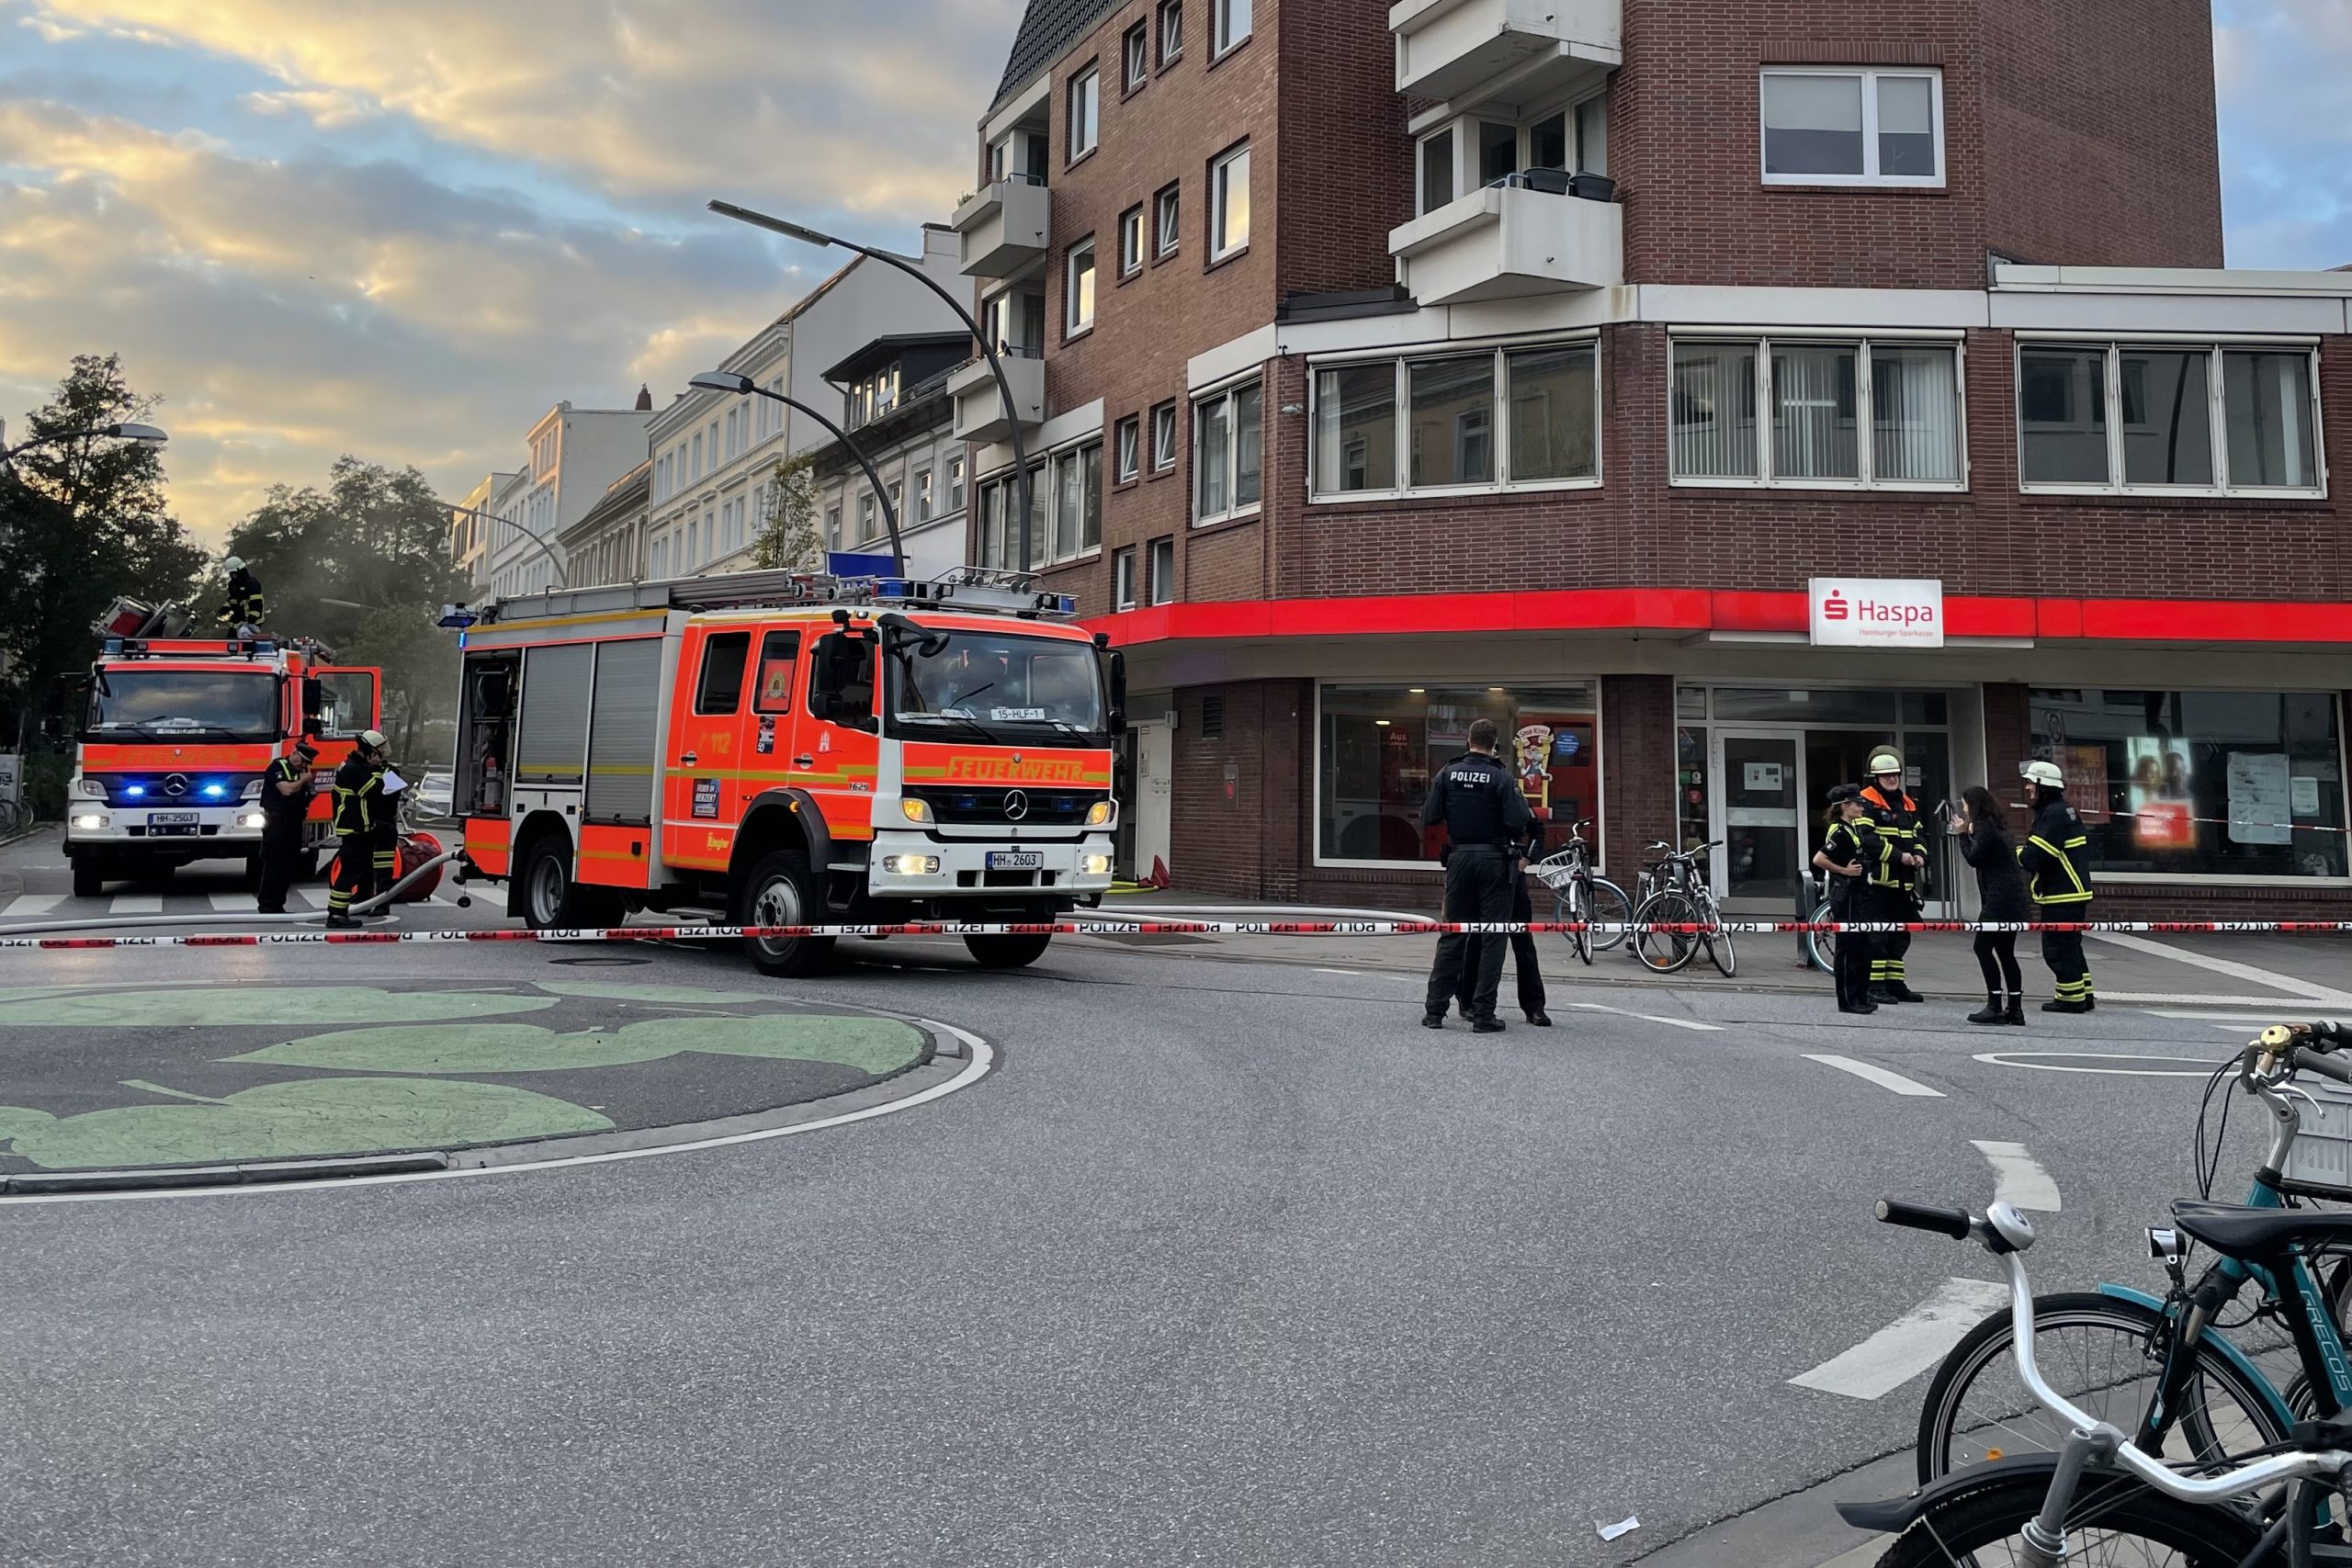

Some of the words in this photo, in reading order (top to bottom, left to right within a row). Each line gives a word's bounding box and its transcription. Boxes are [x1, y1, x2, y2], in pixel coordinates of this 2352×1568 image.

[1859, 599, 1933, 626] Haspa
[1860, 628, 1897, 637] Hamburger
[1899, 628, 1934, 637] Sparkasse
[997, 709, 1039, 719] 15-HLF-1
[711, 732, 732, 754] 112
[947, 756, 1084, 782] FEUERWEHR
[1450, 771, 1490, 784] POLIZEI
[849, 783, 869, 791] 1629
[173, 814, 194, 822] 2503
[993, 854, 1006, 866] HH
[1013, 854, 1036, 866] 2603
[920, 924, 984, 933] POLIZEI
[1079, 923, 1142, 932] POLIZEI
[1158, 923, 1220, 932] POLIZEI
[1236, 923, 1298, 932] POLIZEI
[1314, 922, 1375, 932] POLIZEI
[1391, 922, 1453, 932] POLIZEI
